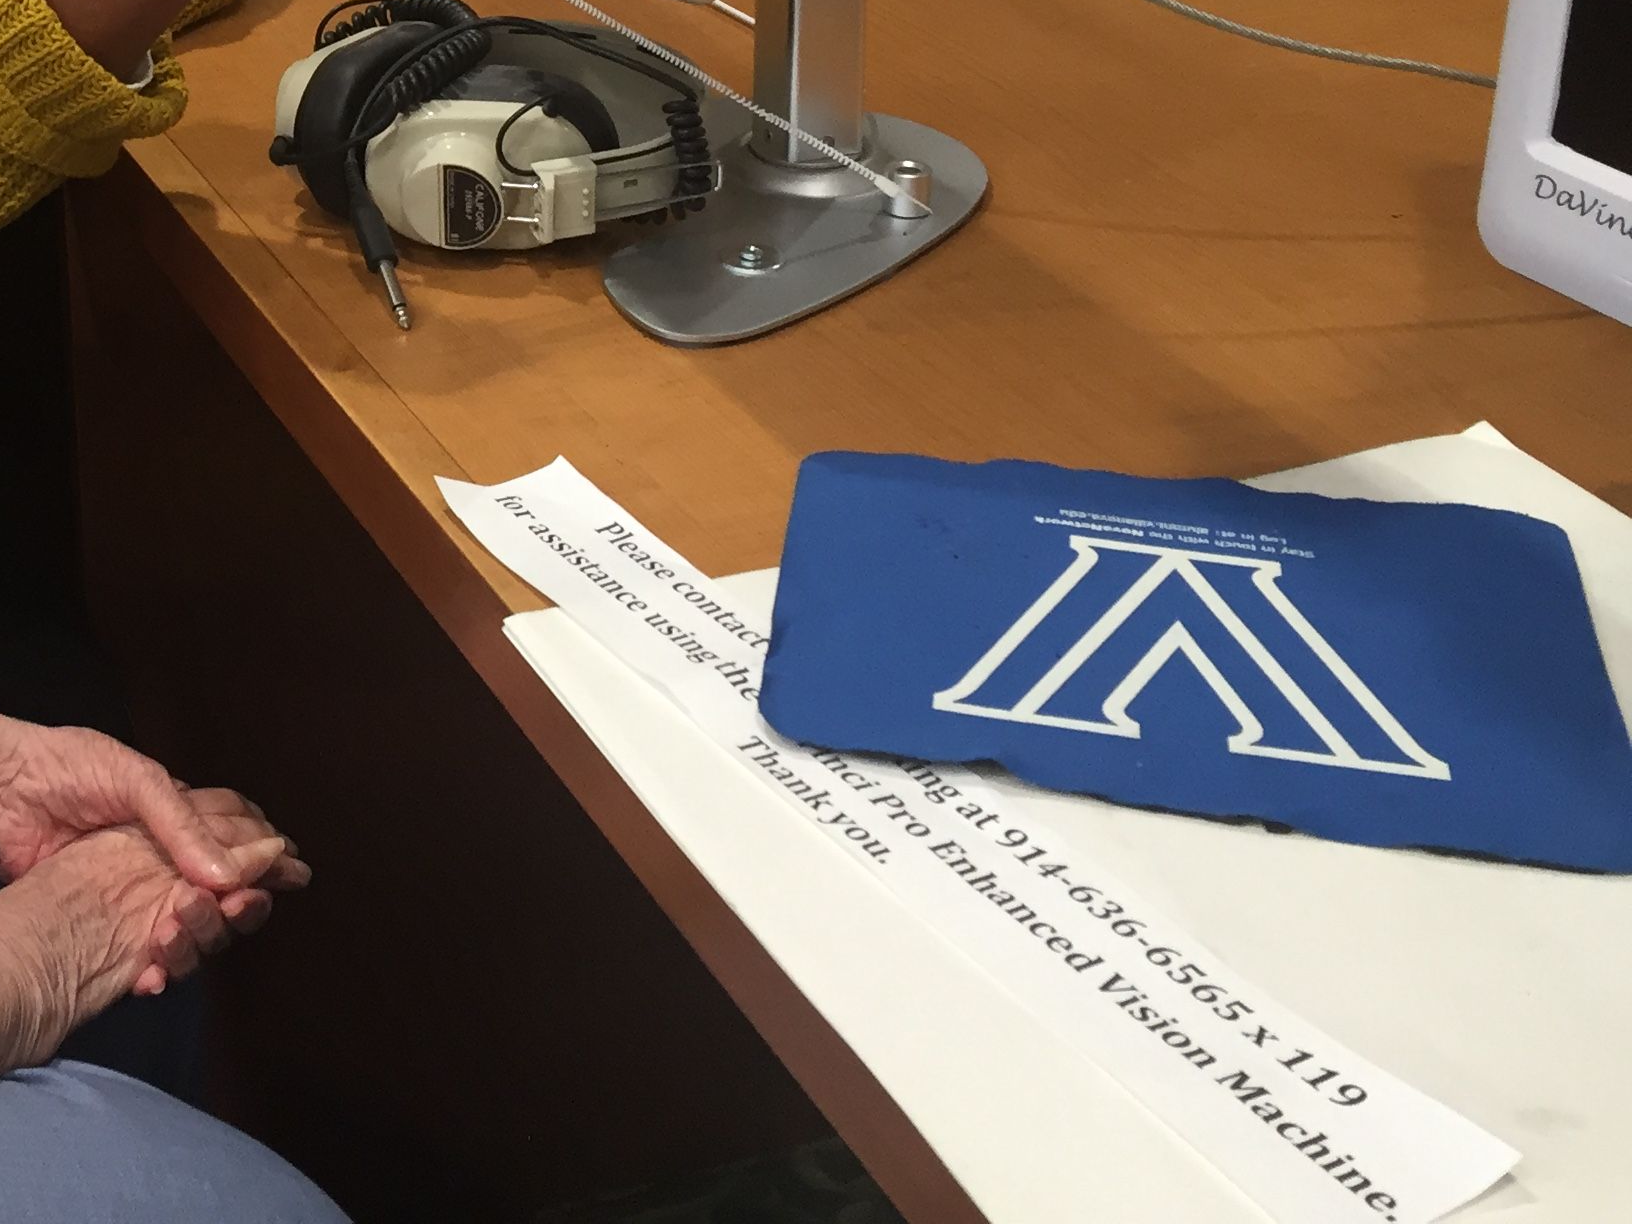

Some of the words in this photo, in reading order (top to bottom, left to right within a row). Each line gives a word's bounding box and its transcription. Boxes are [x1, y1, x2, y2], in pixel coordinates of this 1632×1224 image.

[1033, 514, 1145, 538] NovaNetwork
[1148, 530, 1174, 540] the
[1177, 535, 1210, 545] with
[1258, 534, 1287, 546] Log
[1214, 539, 1257, 552] touch
[1260, 544, 1276, 554] in
[1280, 547, 1316, 559] Stay
[737, 734, 833, 813] Thank
[816, 810, 896, 866] you.
[595, 521, 676, 581] Please
[673, 578, 769, 649] contact
[955, 802, 1001, 832] at
[995, 827, 1256, 1023] 914-636-6565
[1242, 1023, 1280, 1049] x
[1276, 1047, 1369, 1109] 119
[495, 495, 536, 520] for
[529, 523, 648, 612] assistance
[644, 612, 720, 664] using
[715, 661, 762, 703] the
[867, 791, 932, 839] Pro
[927, 839, 1108, 975] Enhanced
[1097, 972, 1220, 1071] Vision
[1214, 1070, 1401, 1224] Machine.
